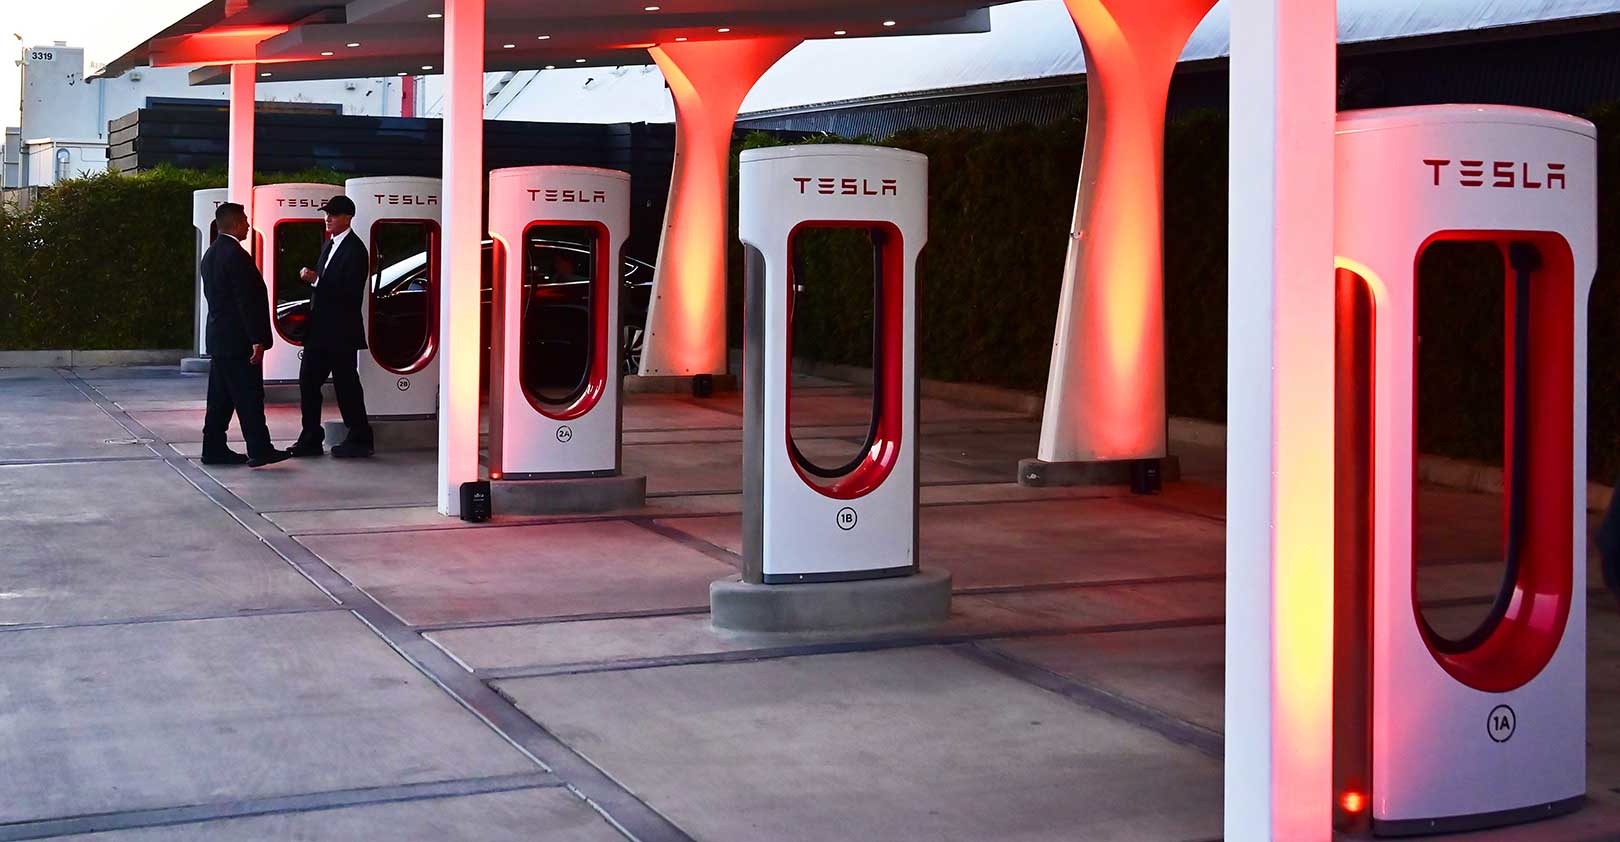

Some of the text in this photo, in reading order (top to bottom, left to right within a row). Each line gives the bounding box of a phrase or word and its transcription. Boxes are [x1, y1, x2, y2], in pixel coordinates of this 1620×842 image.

[32, 52, 53, 60] 3319
[1423, 159, 1565, 189] TESLA
[793, 178, 896, 196] TESLA
[374, 194, 437, 205] TESLA
[527, 189, 605, 203] TESLA
[841, 513, 853, 523] 1B
[1493, 715, 1510, 731] 1A
